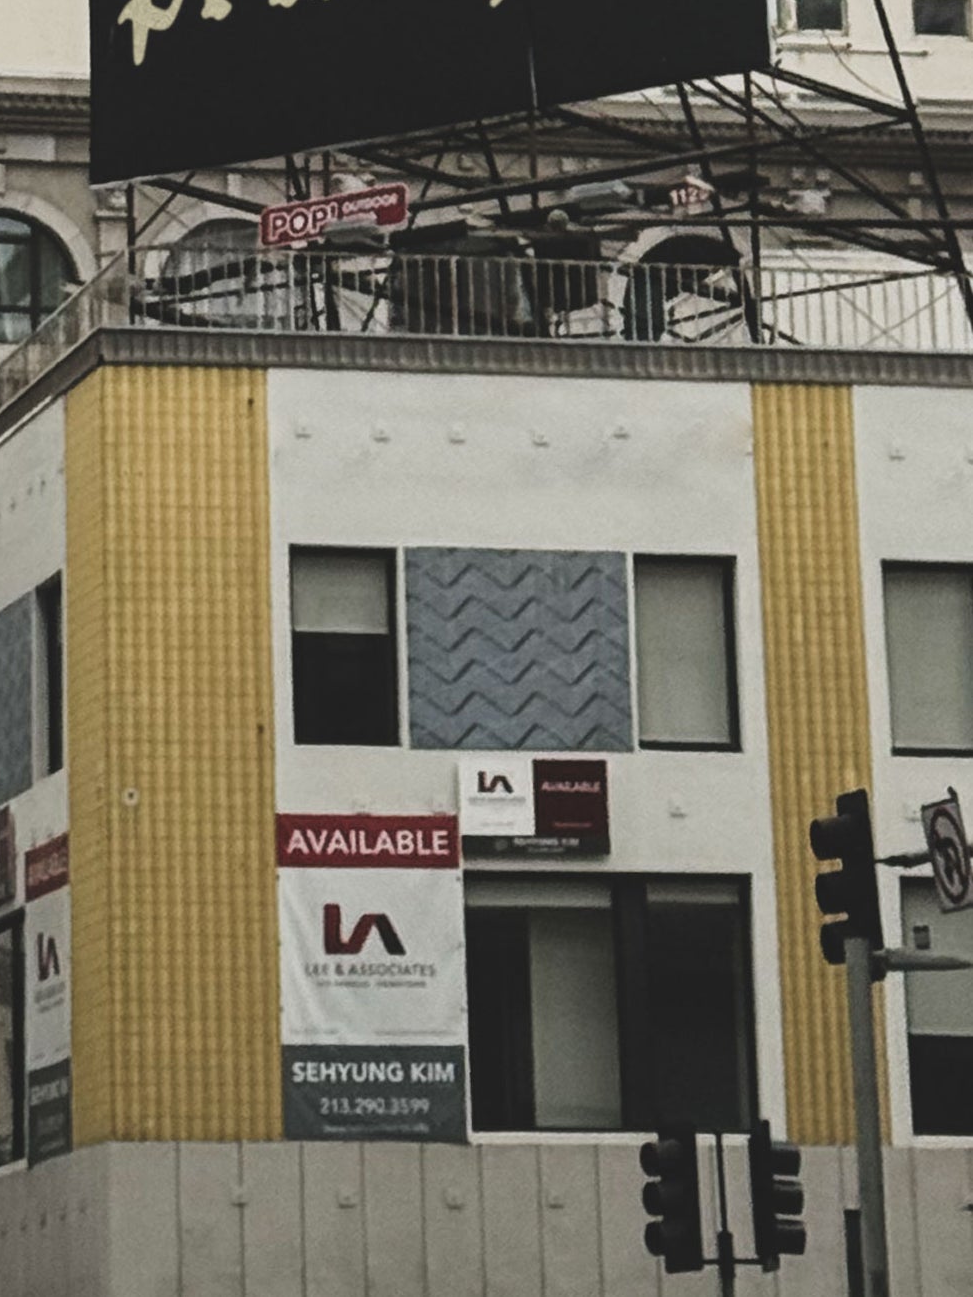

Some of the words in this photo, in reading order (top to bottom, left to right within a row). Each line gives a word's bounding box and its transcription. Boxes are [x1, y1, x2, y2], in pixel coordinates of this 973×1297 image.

[287, 829, 451, 855] AVAILABLE
[292, 1061, 404, 1083] SEHYUNG
[410, 1061, 456, 1083] KIM
